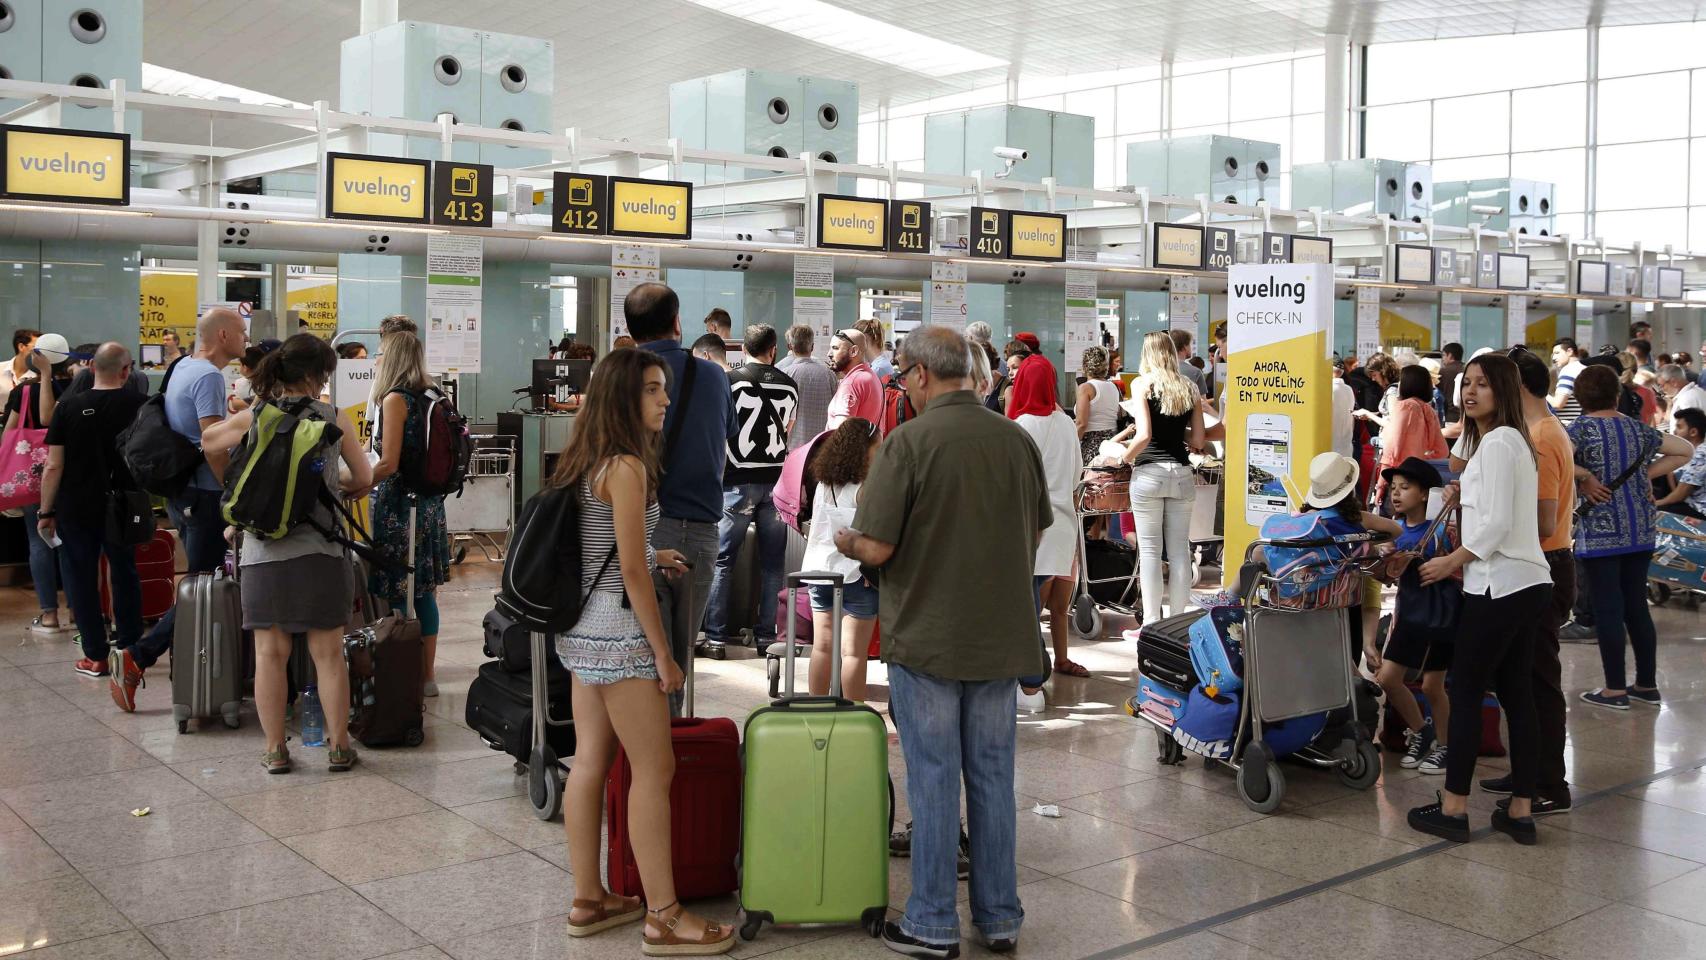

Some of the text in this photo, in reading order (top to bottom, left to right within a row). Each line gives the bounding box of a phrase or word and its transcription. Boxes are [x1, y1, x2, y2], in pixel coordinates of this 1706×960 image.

[20, 151, 106, 181] vueling
[344, 176, 411, 203] vueling
[443, 200, 484, 223] 413
[622, 197, 677, 221] vueling
[561, 209, 599, 230] 412
[829, 213, 875, 234] vueling
[898, 231, 923, 249] 411
[976, 237, 1002, 255] 410
[1018, 227, 1056, 247] vueling
[1162, 239, 1196, 257] vueling
[1208, 253, 1232, 269] 409
[1234, 275, 1306, 304] vueling
[1236, 311, 1302, 325] CHECK-IN
[1253, 361, 1290, 374] AHORA,
[1236, 375, 1306, 388] TODO VUELING
[1239, 390, 1252, 402] EN
[1256, 391, 1269, 402] TU
